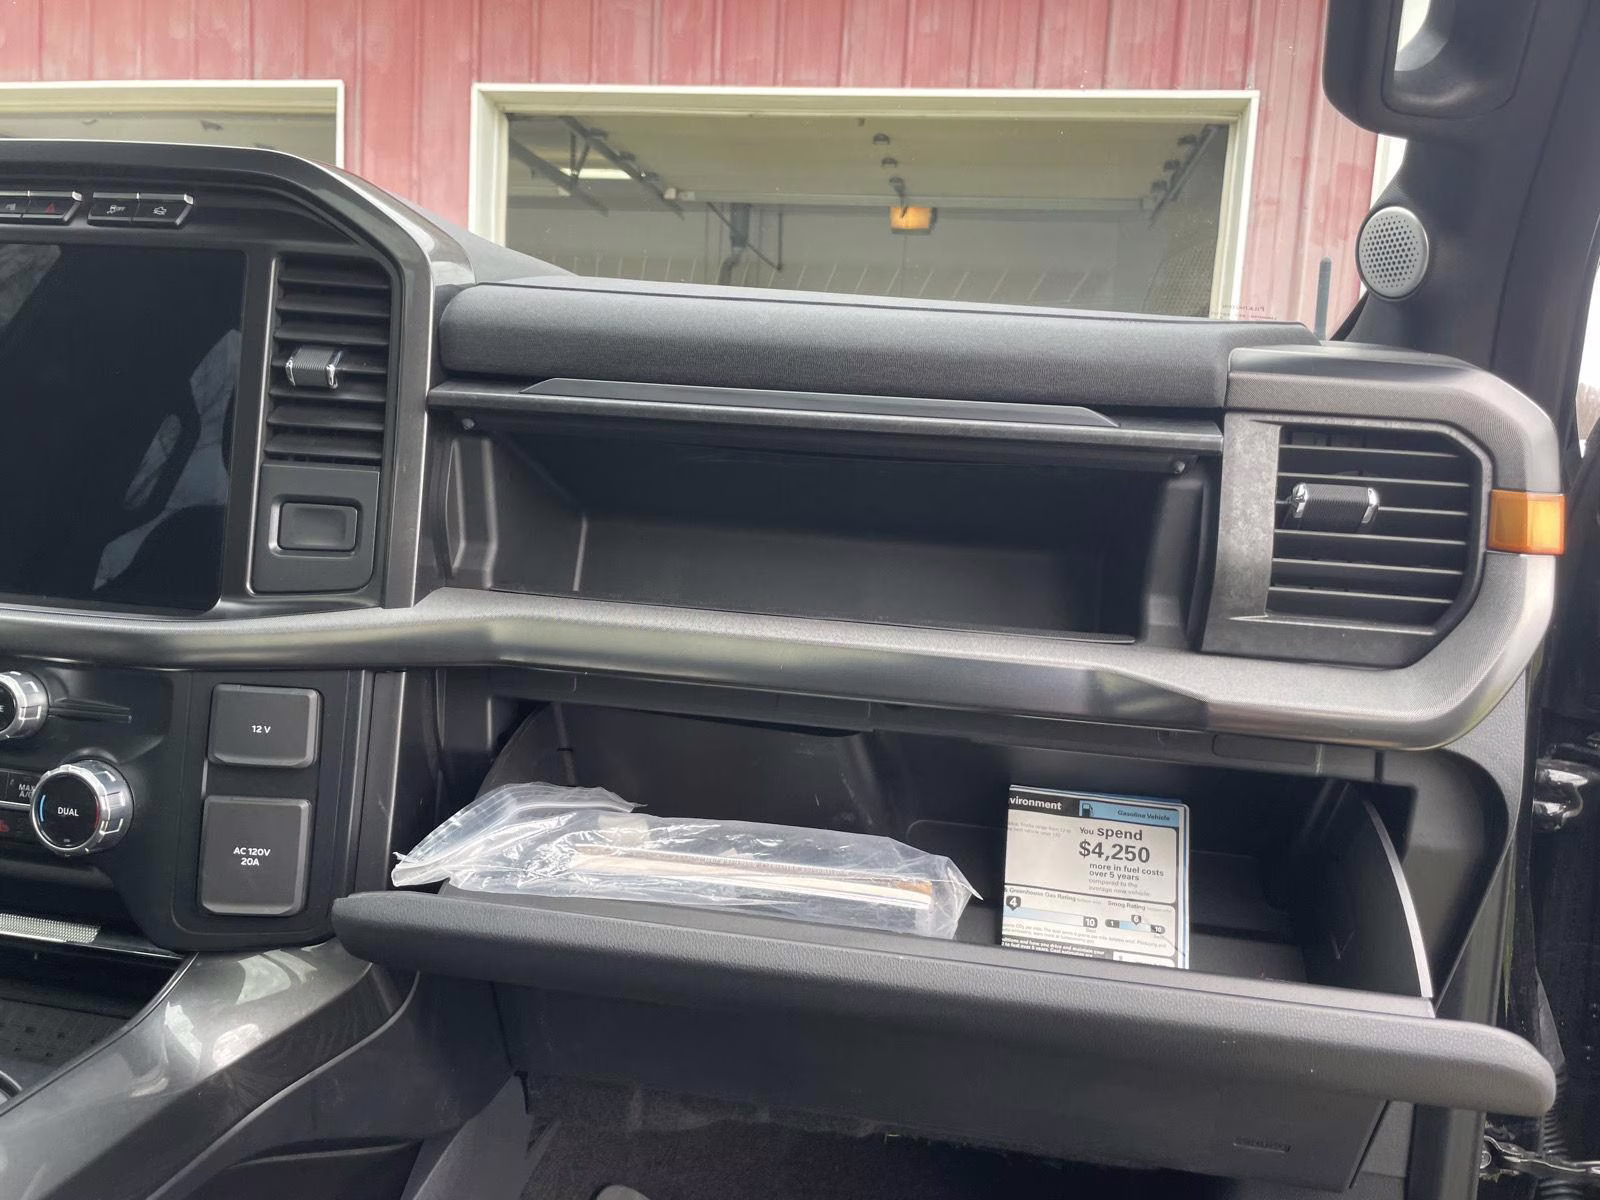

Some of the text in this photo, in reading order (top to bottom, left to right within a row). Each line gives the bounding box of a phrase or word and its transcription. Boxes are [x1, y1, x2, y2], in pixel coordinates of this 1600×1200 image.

[252, 725, 272, 734] 12 V
[58, 806, 79, 816] DUAL
[1117, 810, 1170, 822] Gasoline Vehicle
[1080, 826, 1094, 836] You
[1097, 827, 1143, 841] spend
[233, 846, 271, 857] AC 120V
[1078, 838, 1150, 863] $4,250
[240, 858, 260, 866] 20A
[1089, 863, 1164, 877] more in fuel costs
[1089, 870, 1108, 878] over
[1116, 873, 1140, 882] years
[1010, 896, 1017, 906] 4
[1126, 902, 1146, 911] Rating
[1085, 918, 1095, 926] 10
